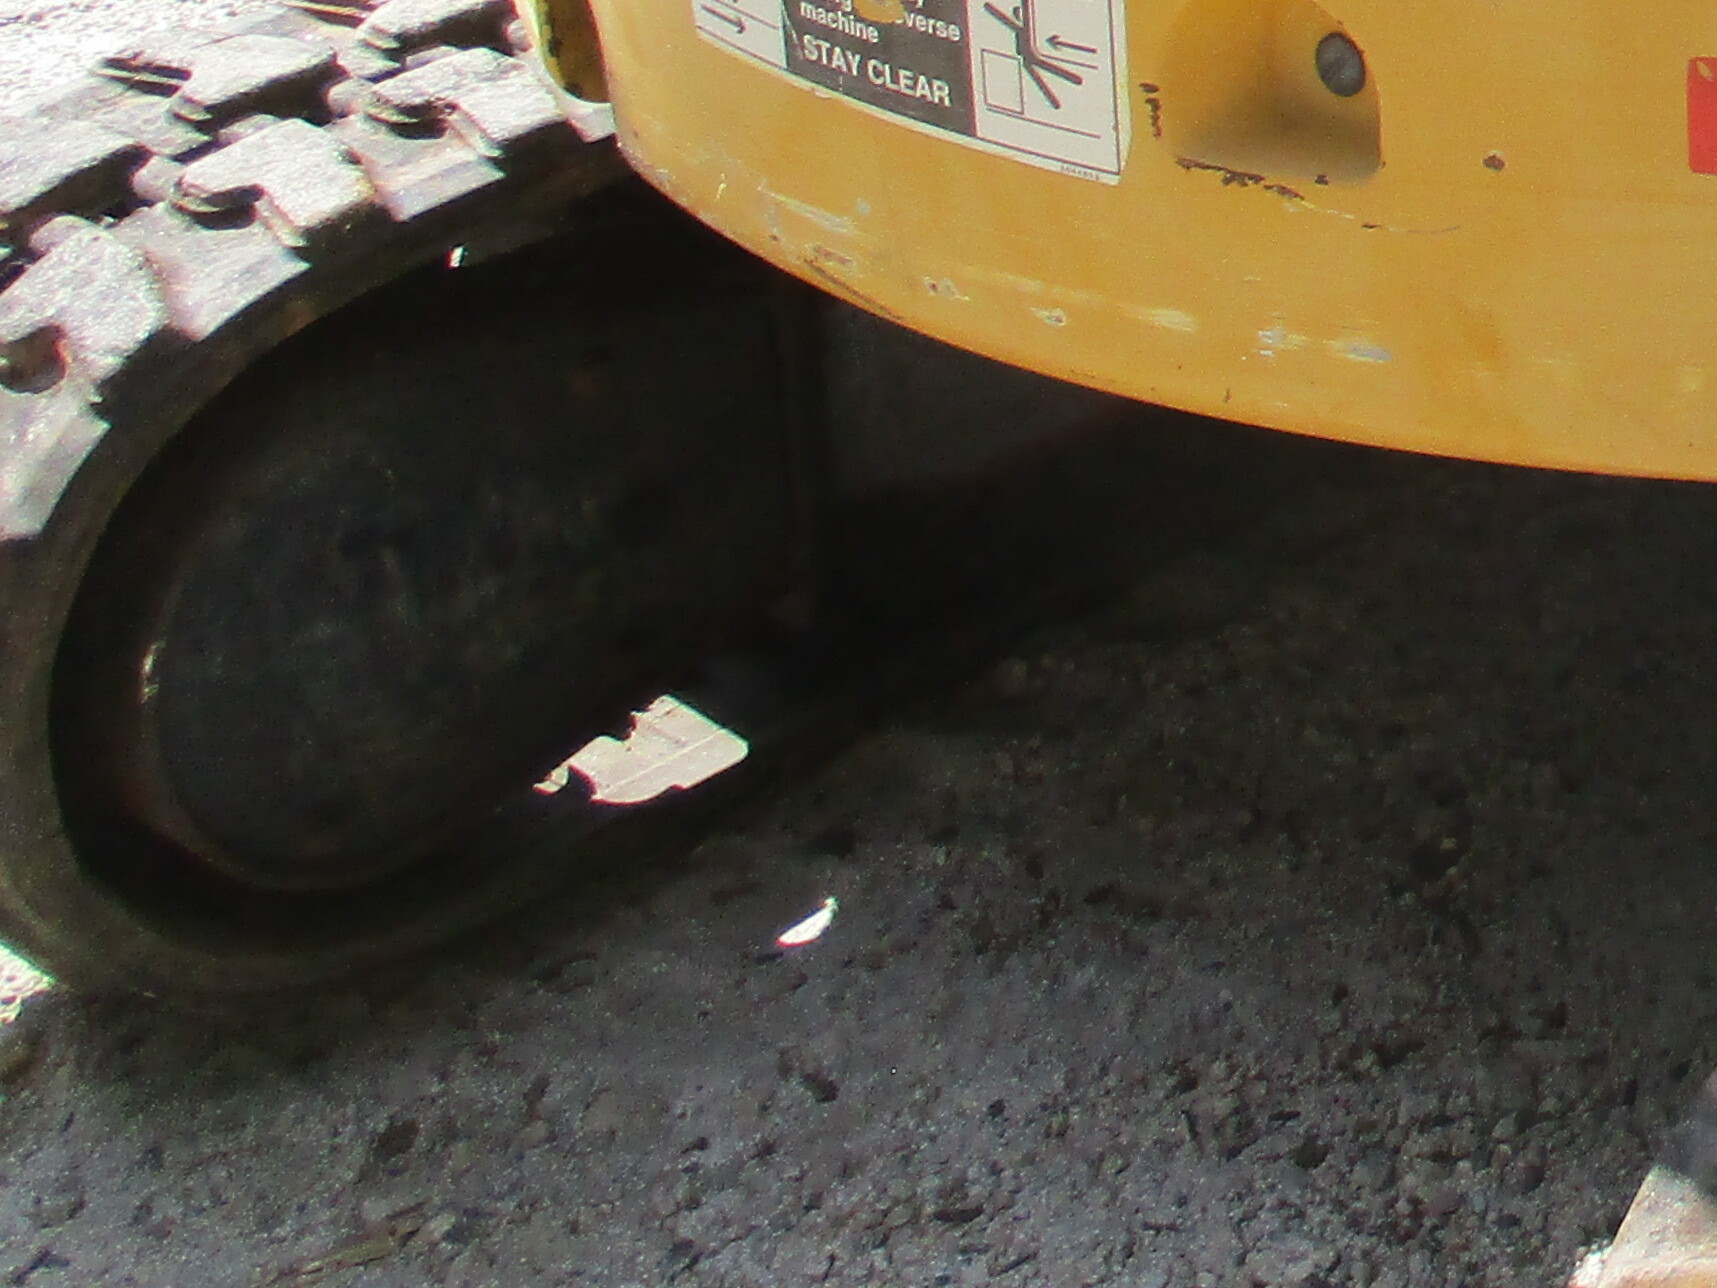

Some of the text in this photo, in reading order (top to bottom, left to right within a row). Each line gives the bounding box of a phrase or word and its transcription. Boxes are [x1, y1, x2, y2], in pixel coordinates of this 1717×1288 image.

[799, 0, 881, 44] machine
[896, 8, 962, 43] verse
[802, 33, 953, 107] STAY CLEAR
